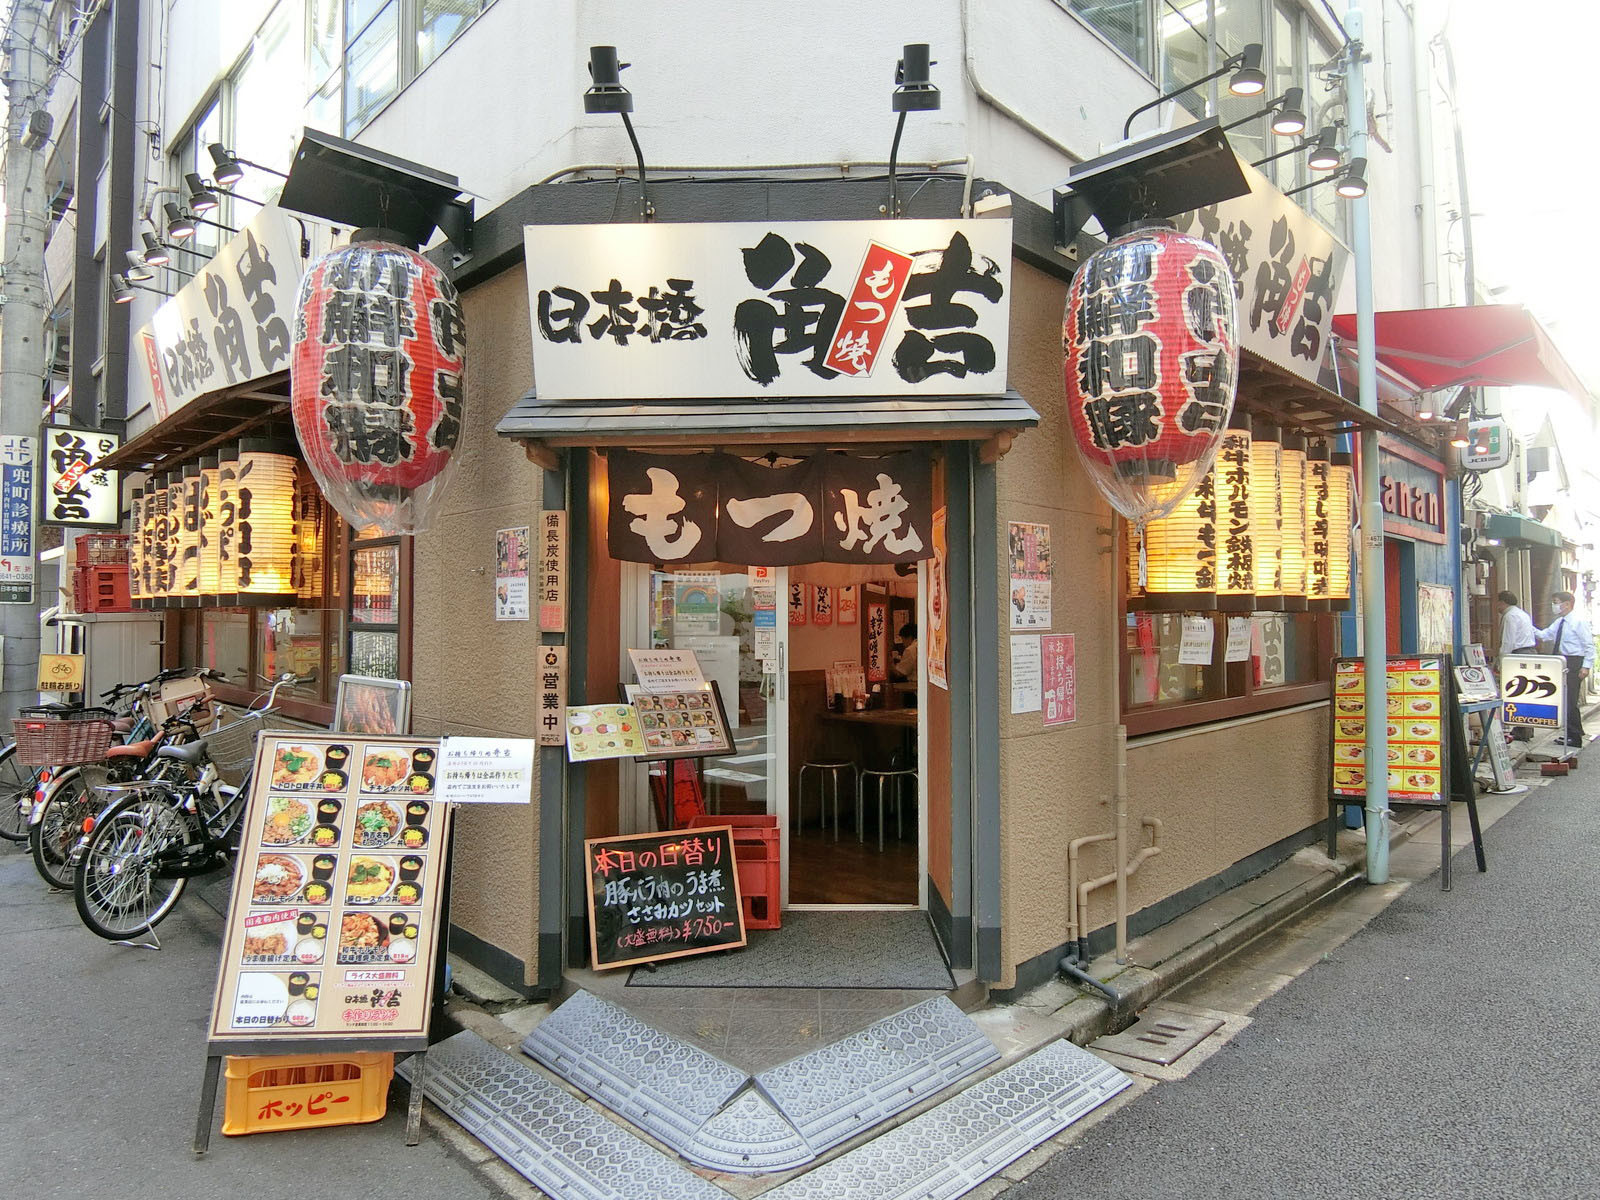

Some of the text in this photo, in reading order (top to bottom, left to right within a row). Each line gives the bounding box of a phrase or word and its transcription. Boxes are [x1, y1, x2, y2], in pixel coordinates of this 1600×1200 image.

[538, 279, 708, 346] 日本橋
[836, 259, 896, 374] もつ焼
[11, 467, 31, 554] 兜町診療所
[621, 466, 925, 560] もつ焼
[545, 513, 560, 602] 備長炭使用店
[41, 681, 80, 690] 駐輪お断り
[542, 672, 560, 731] 営業中
[1528, 717, 1557, 726] COFFEE
[594, 837, 721, 878] 本日の日替り
[258, 1091, 350, 1121] ホッピー
